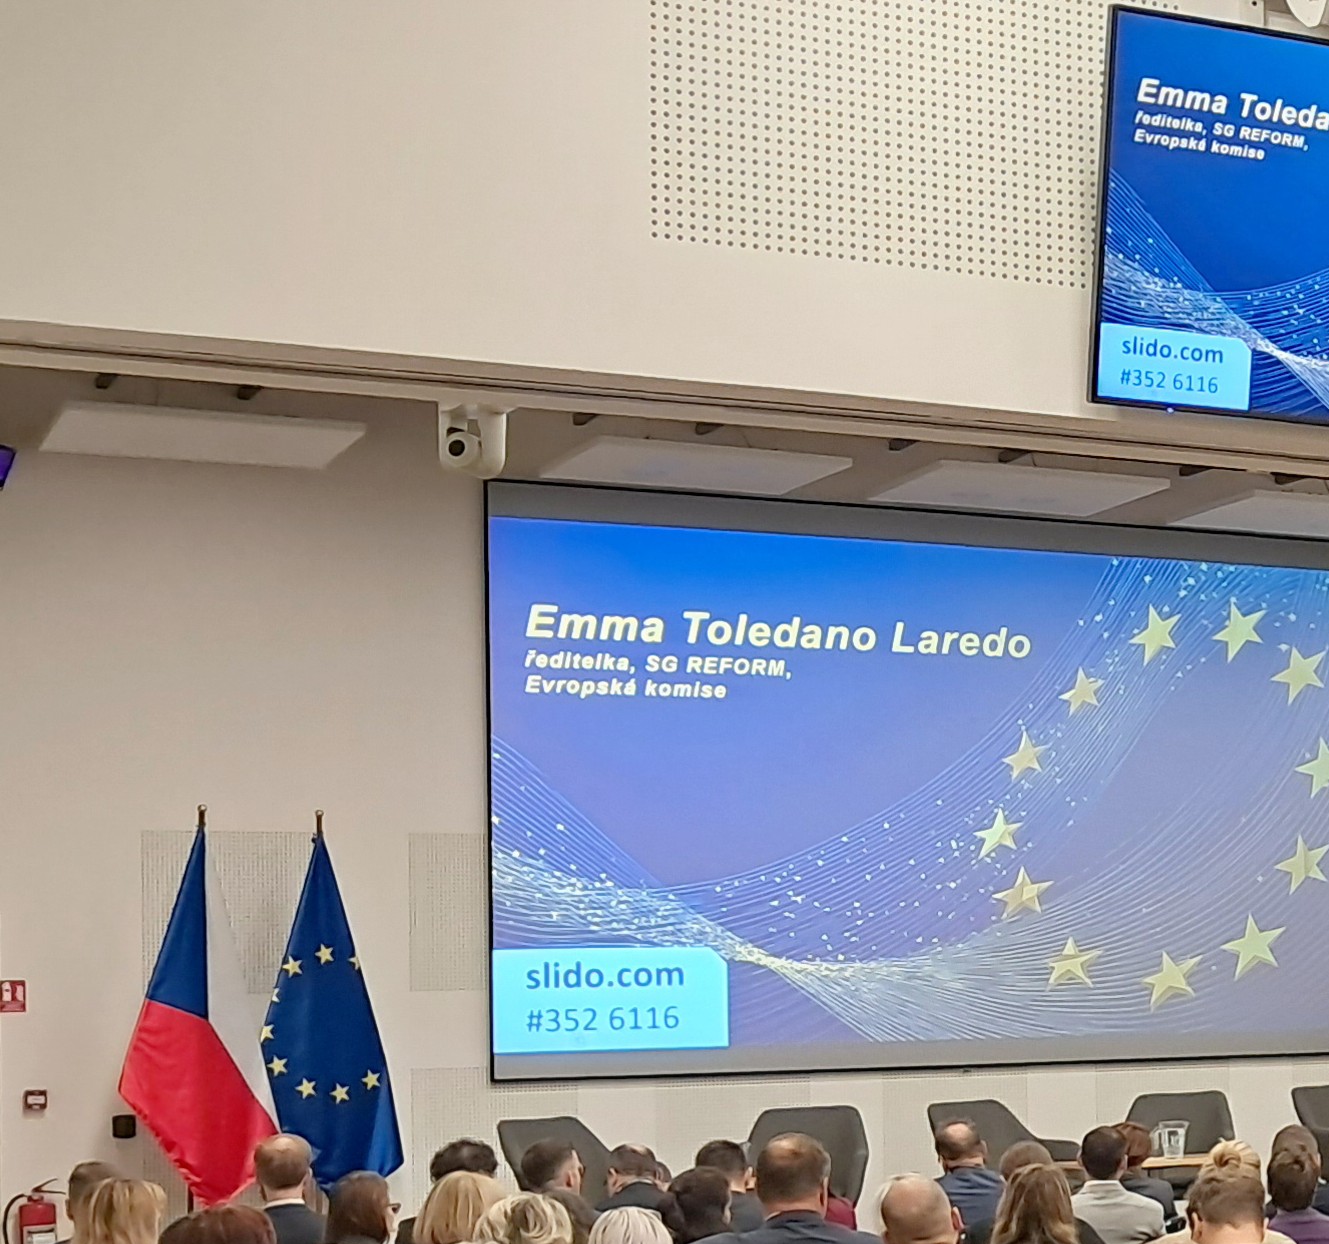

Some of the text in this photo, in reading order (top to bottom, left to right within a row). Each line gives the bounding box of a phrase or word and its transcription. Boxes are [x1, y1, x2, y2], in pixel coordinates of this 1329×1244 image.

[1136, 77, 1228, 114] Emma
[1134, 129, 1265, 160] Evropská komise
[1212, 122, 1235, 137] SG
[1239, 126, 1309, 151] REFORM,
[1122, 336, 1223, 364] slido.com
[1120, 368, 1218, 394] #352 6116
[525, 603, 1032, 659] Emma Toledano Laredo
[524, 650, 792, 680] ředitelka, SG REFORM,
[524, 675, 727, 699] Evropská komise
[526, 961, 684, 989] slido.com
[526, 1006, 679, 1032] #352 6116
